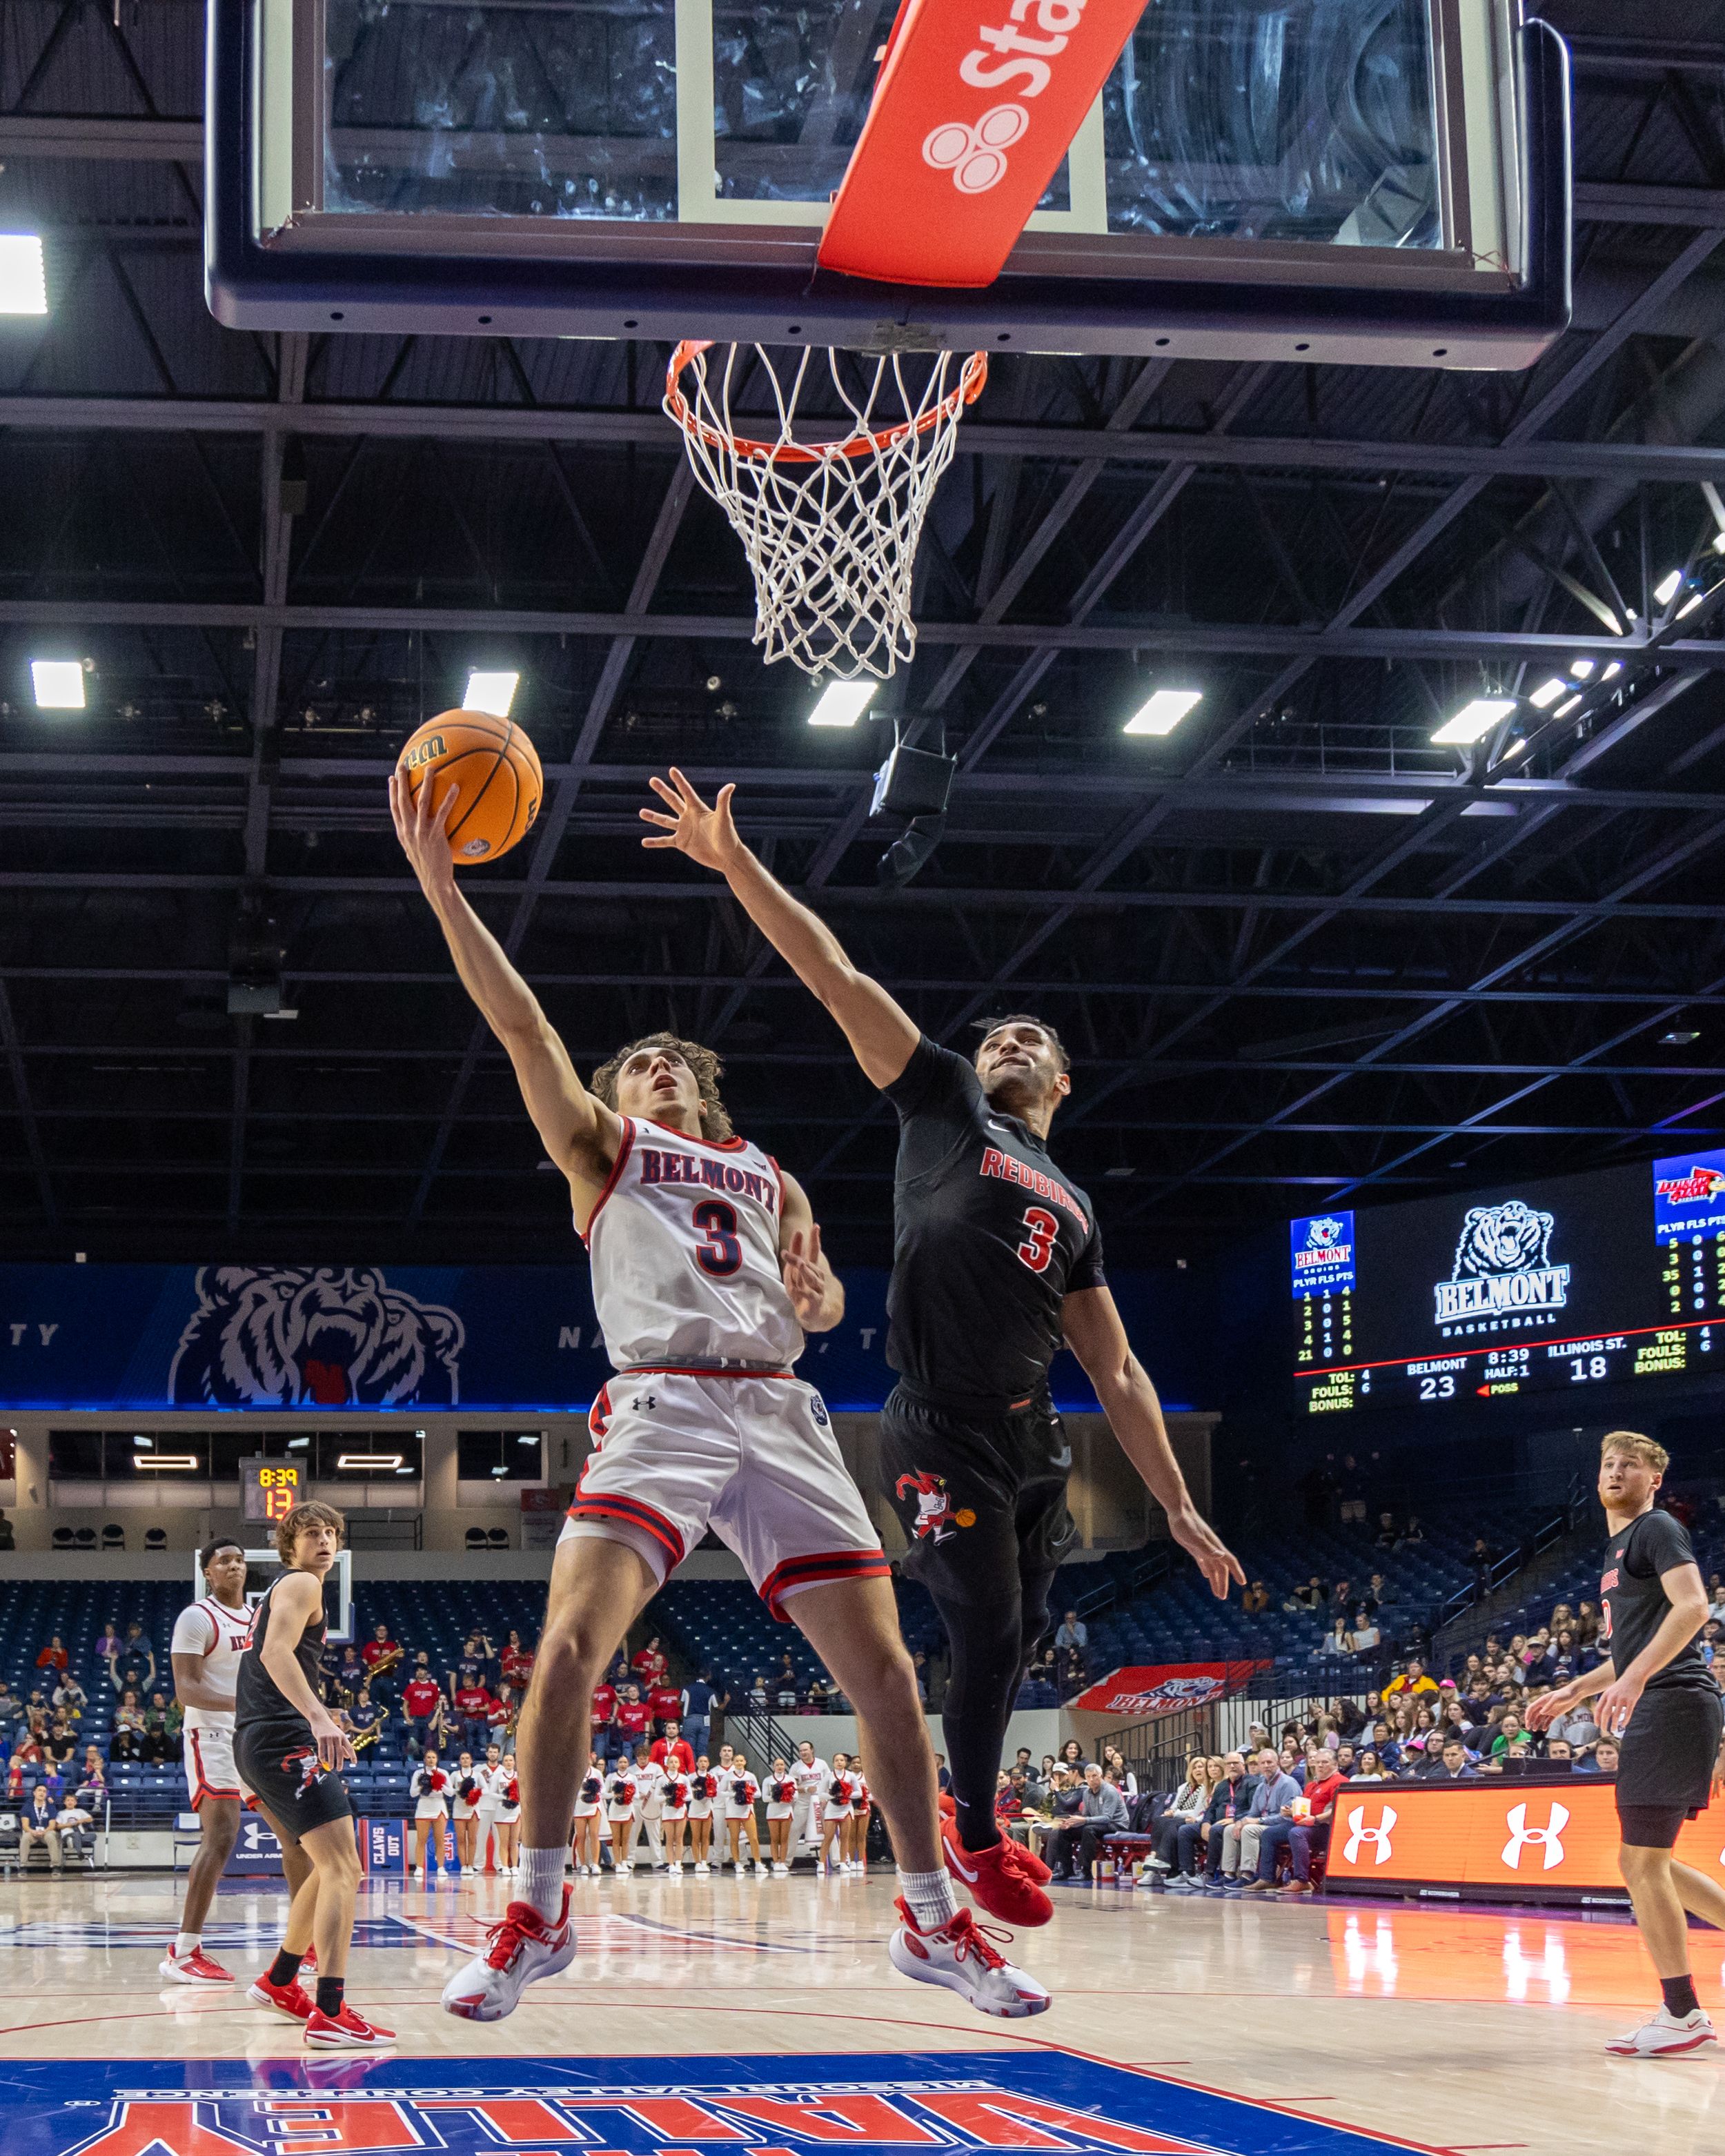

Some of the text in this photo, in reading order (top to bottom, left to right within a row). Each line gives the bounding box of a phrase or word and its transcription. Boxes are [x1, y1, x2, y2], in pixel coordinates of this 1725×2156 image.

[640, 1149, 776, 1215] BELMONT
[1657, 1222, 1685, 1234] PLYR
[1686, 1218, 1706, 1229] FLS
[693, 1200, 742, 1276] 3
[1017, 1206, 1059, 1274] 3
[1669, 1231, 1725, 1249] 5 0 6
[1297, 1246, 1350, 1267] BELMONT
[1669, 1254, 1678, 1265] 3
[1693, 1249, 1703, 1261] 0
[1293, 1272, 1353, 1288] PLYR FLS PTS
[1662, 1263, 1725, 1282] 35 1 2
[1303, 1286, 1350, 1303] 1 1 4
[1439, 1268, 1567, 1318] BELMONT
[1669, 1278, 1725, 1296] 0 0 2
[1303, 1300, 1351, 1316] 2 0 1
[1670, 1301, 1681, 1313] 2
[1694, 1298, 1704, 1309] 0
[1304, 1316, 1351, 1331] 3 0 5
[1442, 1314, 1556, 1337] BASKETBALL
[1304, 1329, 1351, 1345] 4 1 4
[1655, 1326, 1710, 1344] TOL: 4
[1299, 1345, 1352, 1361] 21 0 0
[1548, 1337, 1627, 1357] ILLINOIS ST.
[1637, 1340, 1711, 1360] FOULS: 6
[1488, 1348, 1529, 1365] 8:39
[1407, 1357, 1467, 1376] BELMONT
[1484, 1365, 1530, 1379] HALF: 1
[1570, 1356, 1606, 1381] 18
[1634, 1358, 1685, 1374] BONUS:
[1328, 1369, 1370, 1384] TOL: 4
[1312, 1383, 1370, 1399] FOULS: 6
[1420, 1376, 1455, 1400] 23
[1490, 1383, 1518, 1394] POSS
[1309, 1397, 1352, 1412] BONUS:
[259, 1468, 297, 1487] 8:39
[266, 1488, 293, 1521] 13
[373, 1827, 385, 1864] CLAWS
[388, 1835, 400, 1857] OUT
[115, 2080, 998, 2098] MISSOURI VALLEY CONFERENCE
